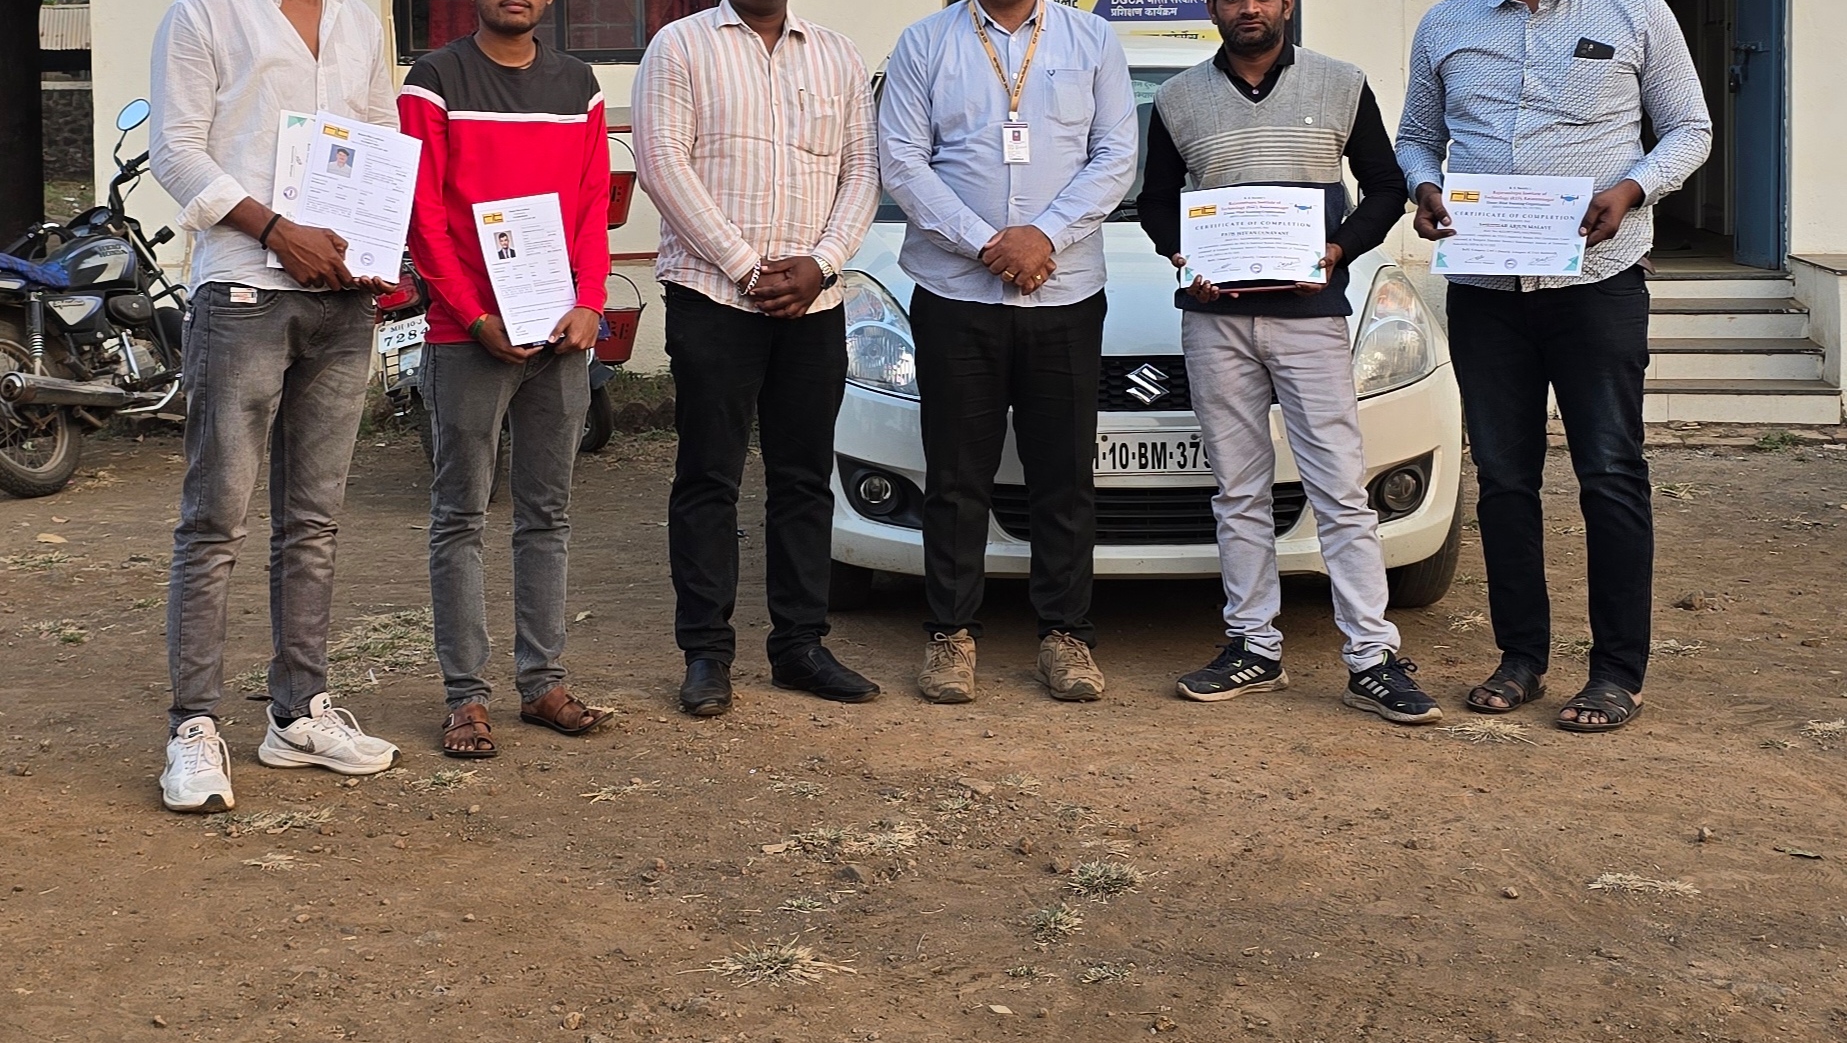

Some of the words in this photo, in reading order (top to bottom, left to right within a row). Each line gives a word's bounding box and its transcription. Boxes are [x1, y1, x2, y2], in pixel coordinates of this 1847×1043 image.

[1110, 5, 1142, 17] प्रशिक्षण
[1144, 5, 1178, 16] कार्यक्रम
[1195, 221, 1244, 230] CERTIFICATE
